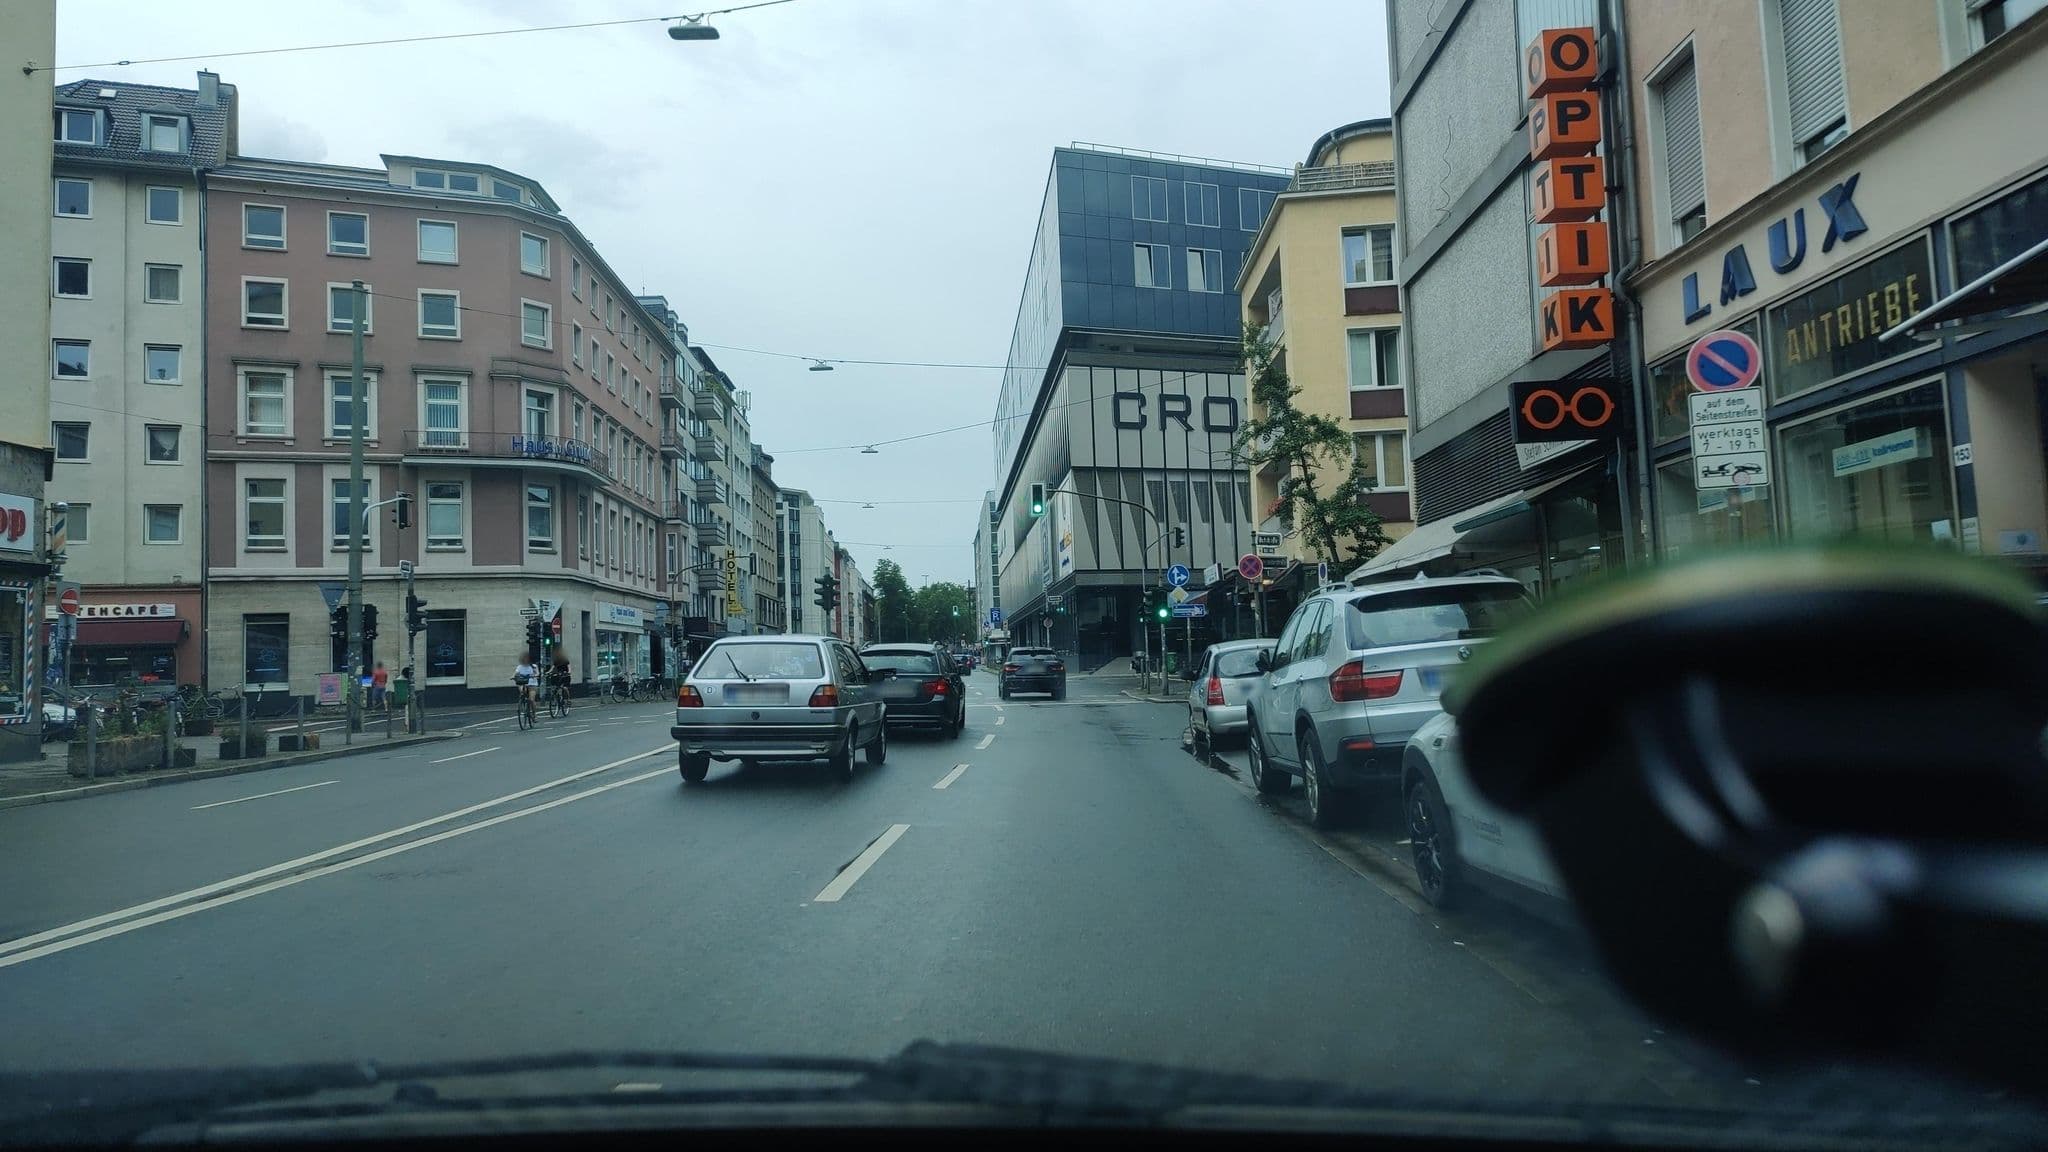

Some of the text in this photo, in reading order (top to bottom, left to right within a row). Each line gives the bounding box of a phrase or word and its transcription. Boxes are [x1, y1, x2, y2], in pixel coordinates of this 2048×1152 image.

[1528, 46, 1561, 342] OPTIK
[1551, 34, 1604, 333] OPTIK
[1682, 172, 1868, 325] LAUX
[1787, 274, 1920, 366] ANTRIEBE
[1695, 407, 1759, 421] Seitenstreifen
[1706, 398, 1745, 409] auf dem
[1698, 427, 1760, 440] werktags
[1703, 442, 1710, 452] 7
[1730, 440, 1742, 450] 19
[1748, 440, 1756, 449] h
[727, 549, 736, 604] HOTEL
[76, 604, 158, 617] TEHCAFÉ
